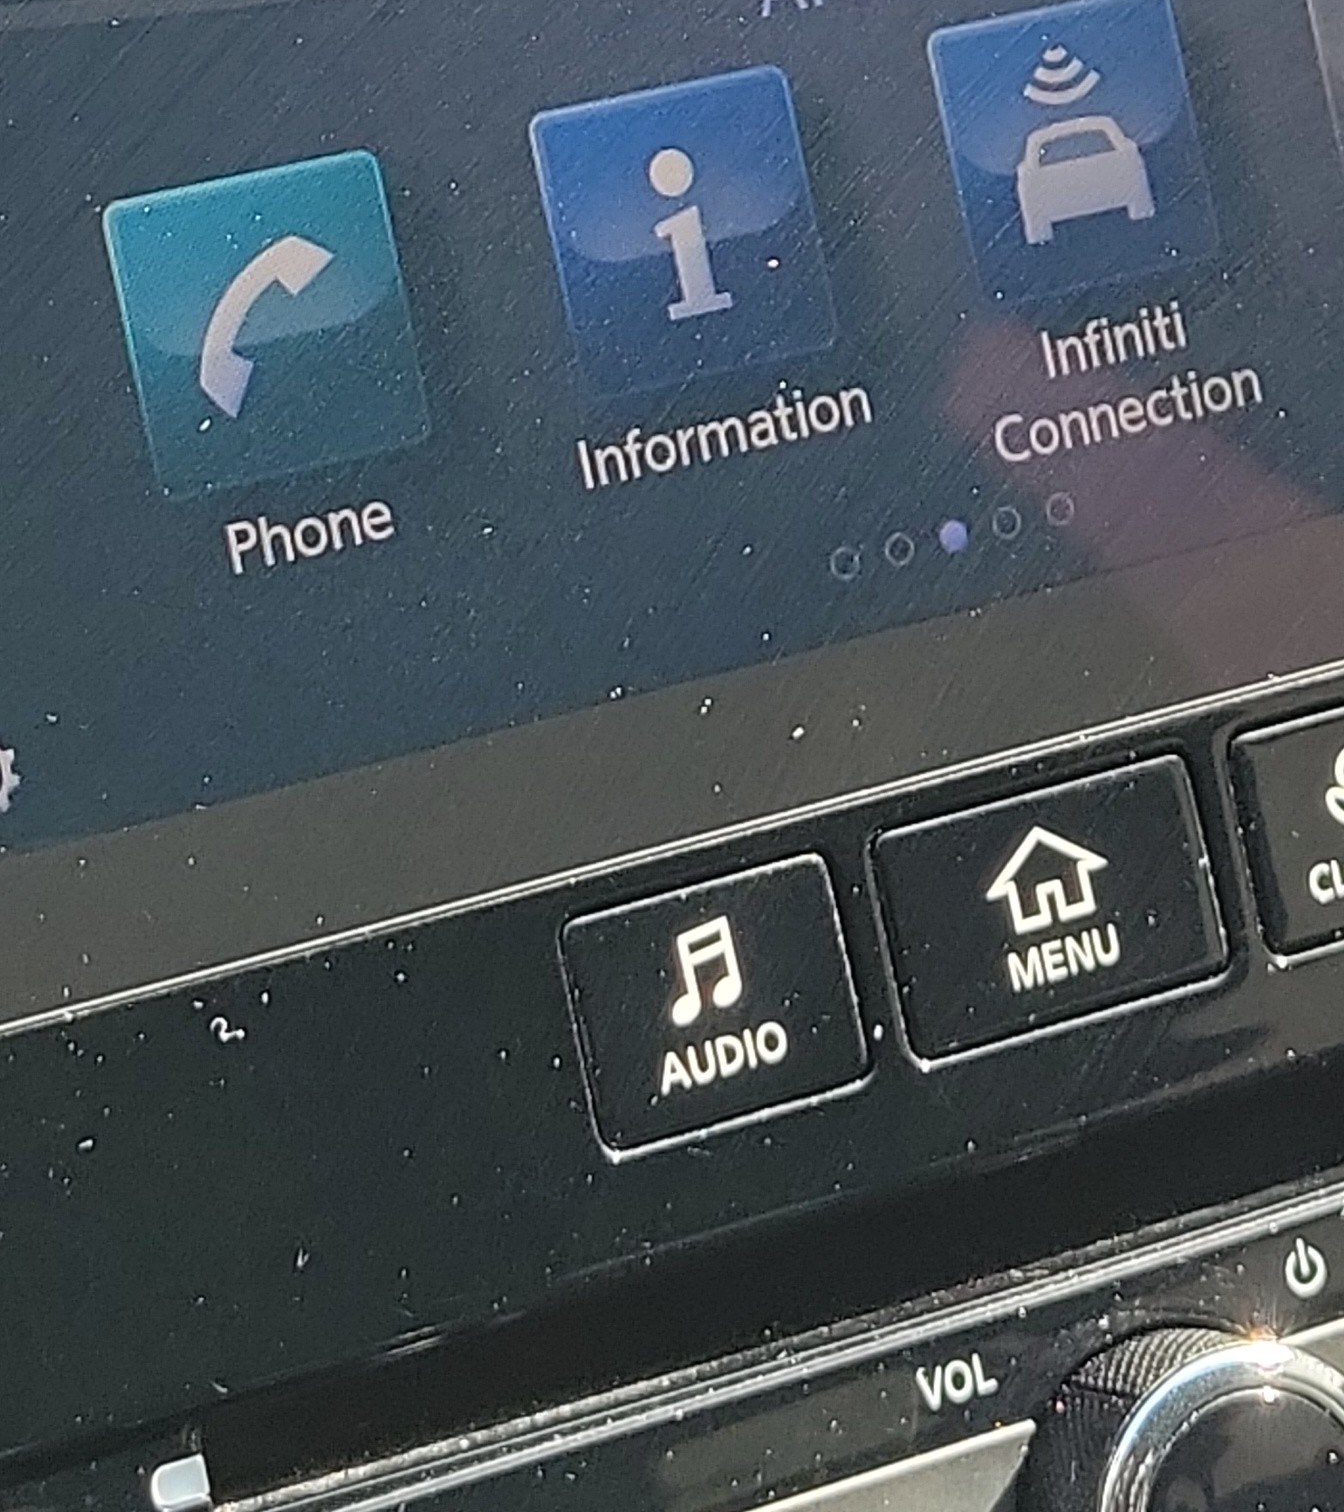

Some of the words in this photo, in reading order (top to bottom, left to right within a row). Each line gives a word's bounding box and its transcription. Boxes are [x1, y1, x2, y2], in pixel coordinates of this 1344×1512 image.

[1040, 300, 1188, 380] Infiniti
[577, 384, 874, 491] Information
[993, 364, 1264, 464] Connection
[224, 498, 396, 576] Phone
[1007, 922, 1121, 993] MENU
[659, 1020, 789, 1096] AUDIO
[915, 1352, 999, 1411] VOL
